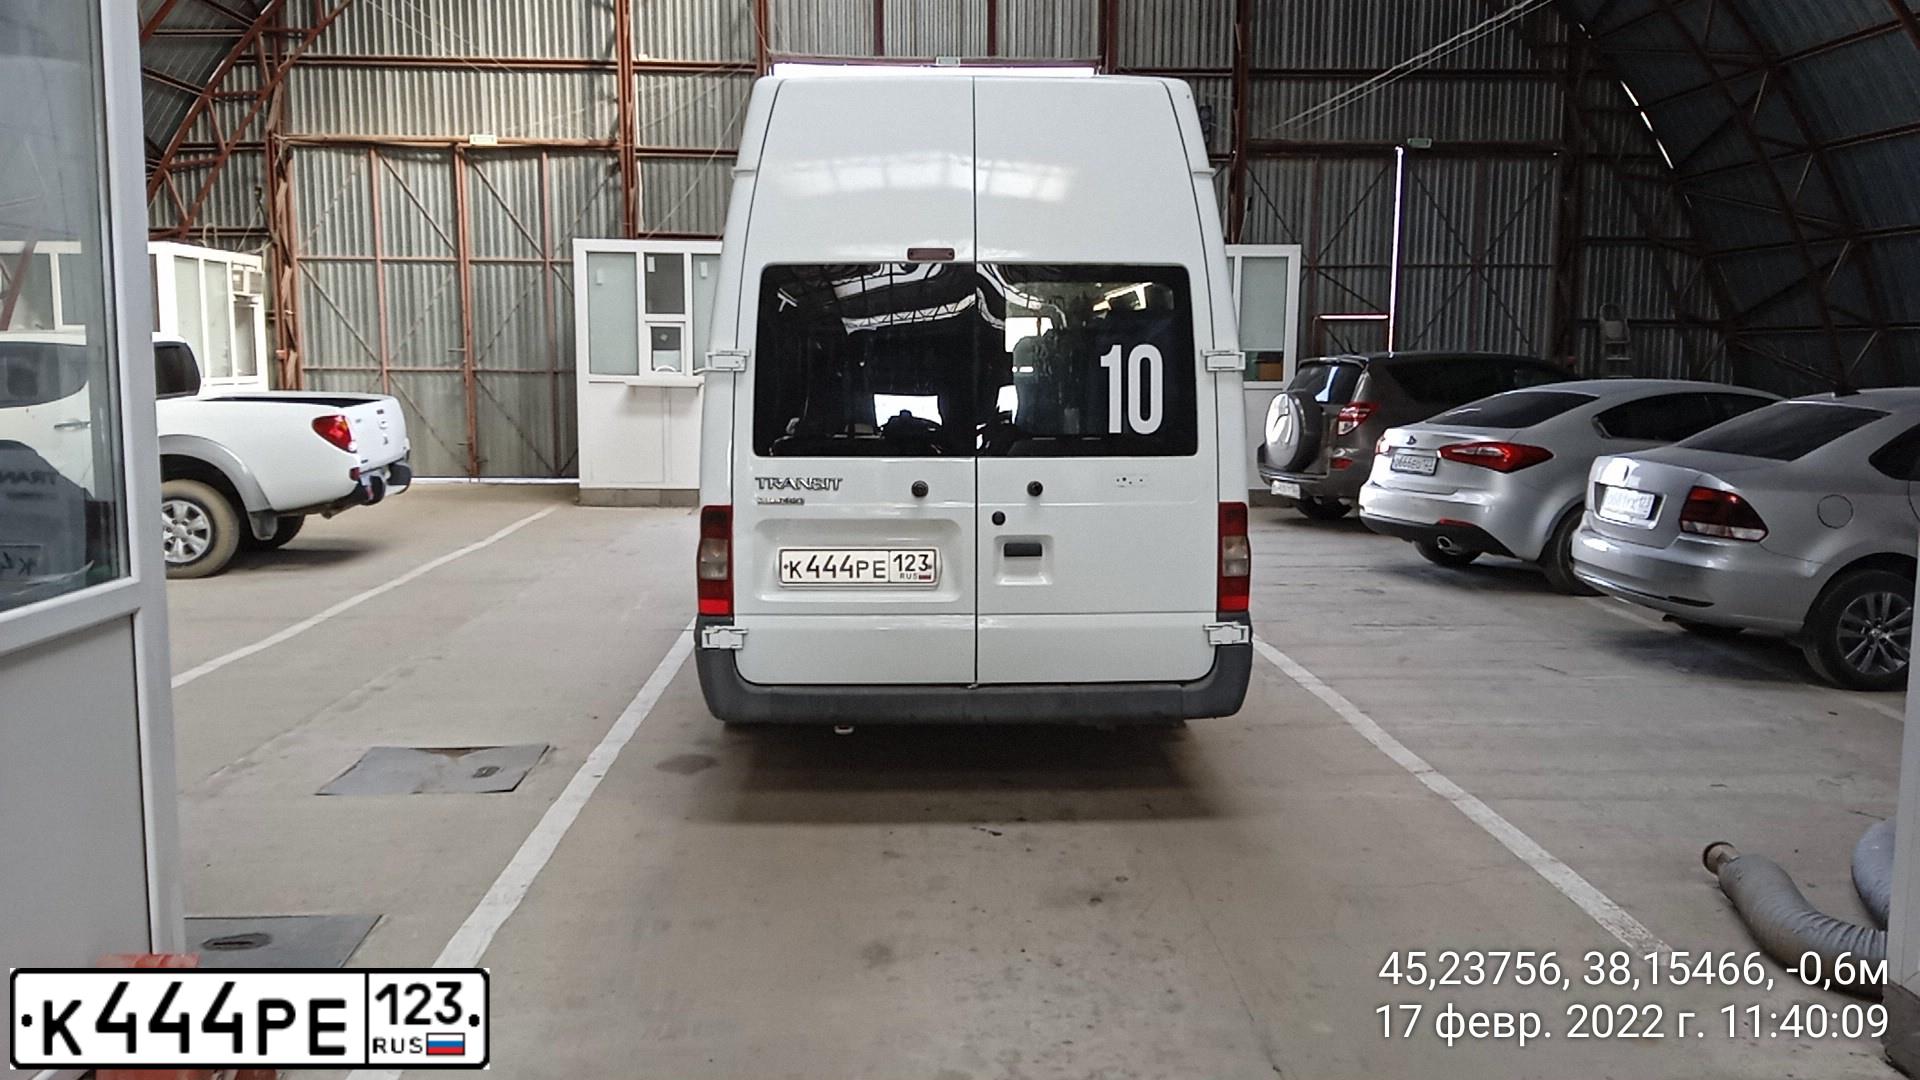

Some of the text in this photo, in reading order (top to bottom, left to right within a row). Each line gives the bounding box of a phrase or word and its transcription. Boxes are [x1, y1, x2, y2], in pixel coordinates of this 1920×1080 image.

[1099, 344, 1164, 435] 10
[754, 476, 843, 491] TRANSIT
[893, 553, 929, 572] 123
[899, 572, 918, 580] RUS
